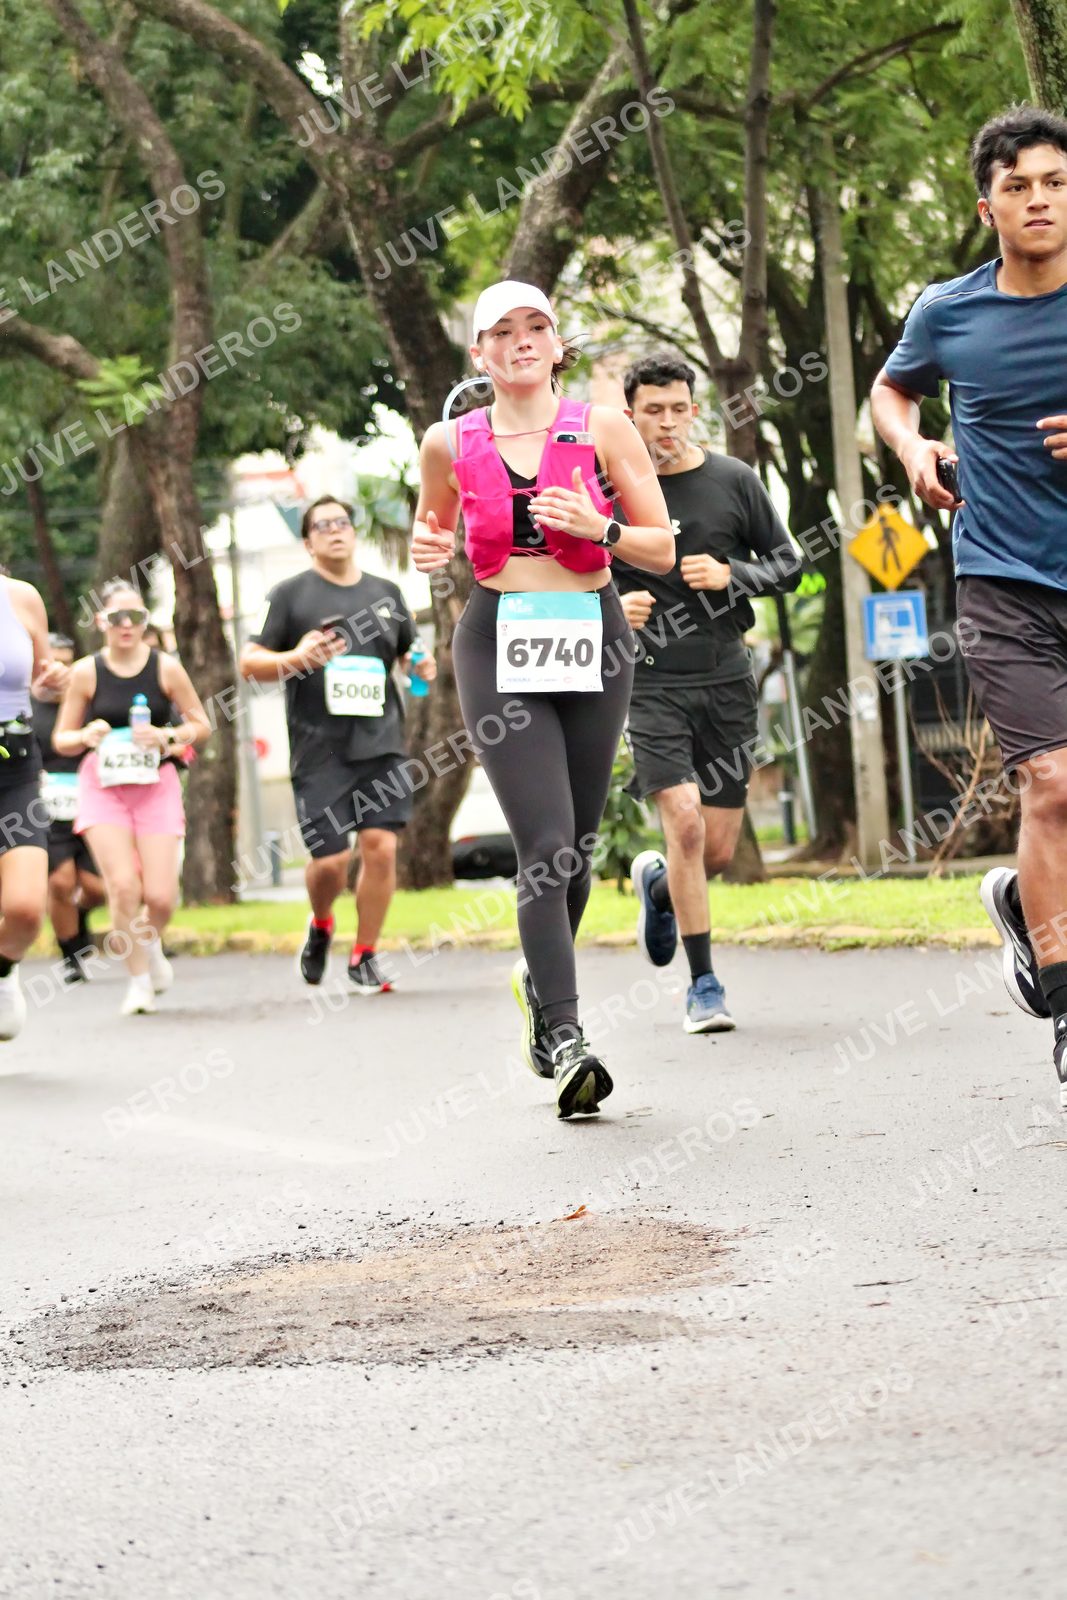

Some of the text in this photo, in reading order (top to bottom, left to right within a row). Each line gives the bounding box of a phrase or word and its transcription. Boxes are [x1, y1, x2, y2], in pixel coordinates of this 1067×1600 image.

[507, 638, 594, 668] 6740
[332, 683, 381, 700] 5008
[103, 753, 155, 768] 4258
